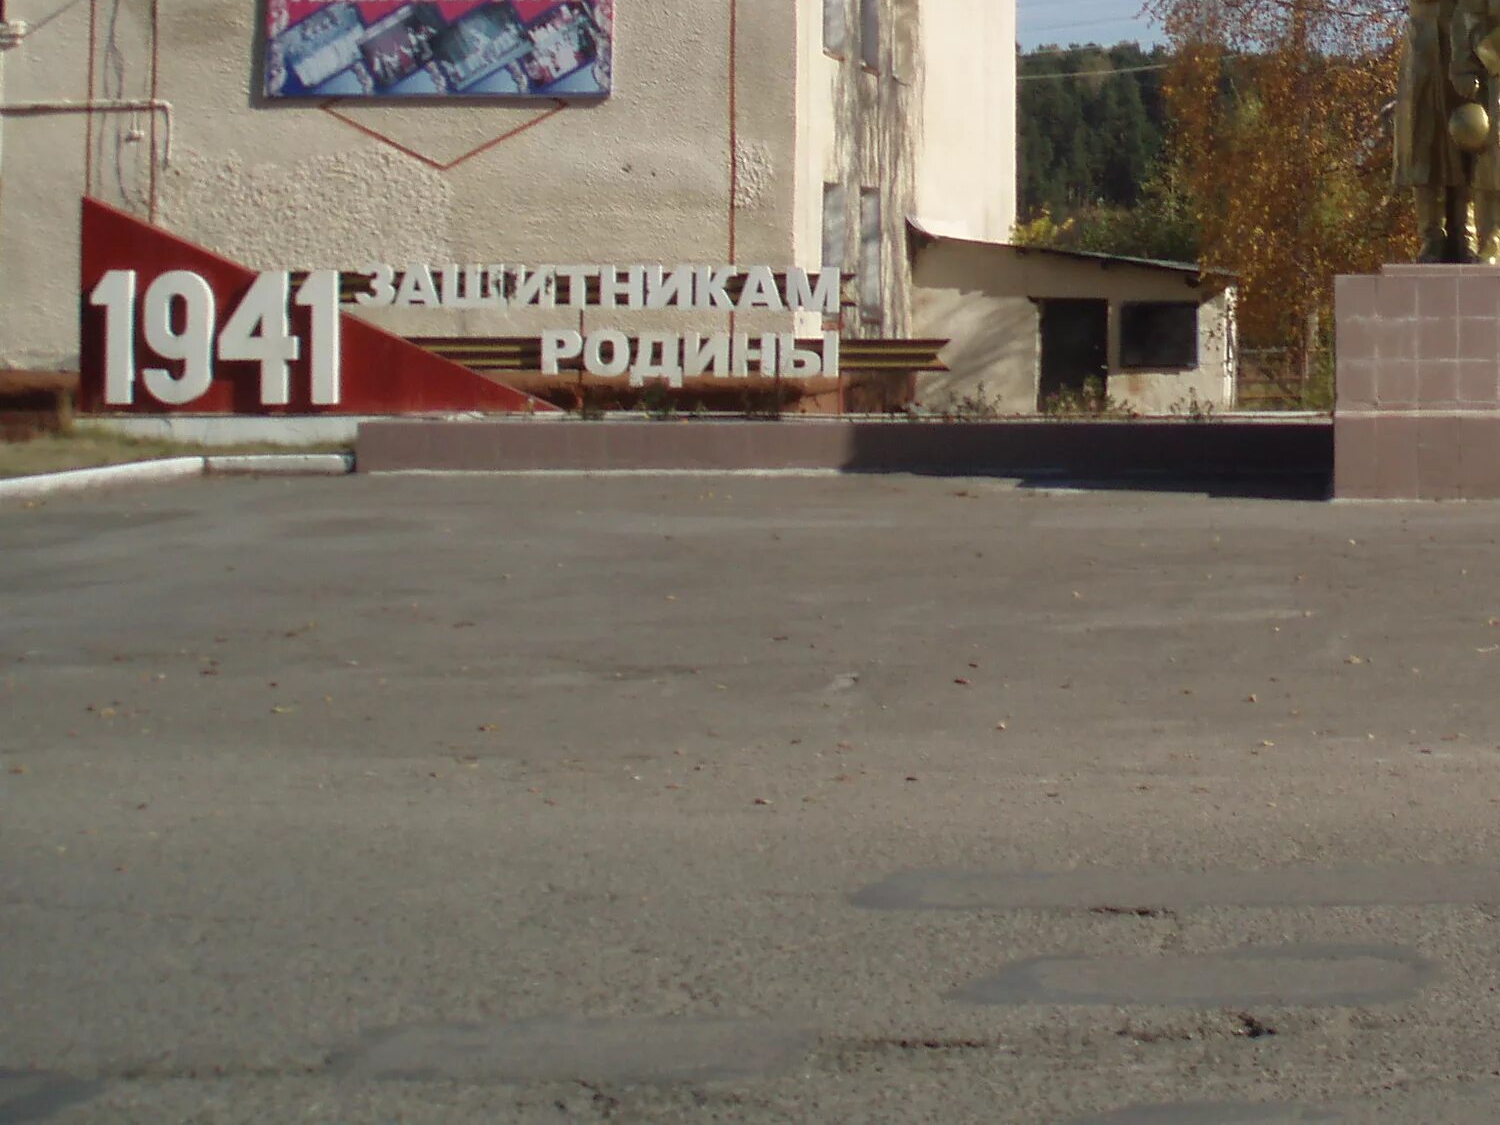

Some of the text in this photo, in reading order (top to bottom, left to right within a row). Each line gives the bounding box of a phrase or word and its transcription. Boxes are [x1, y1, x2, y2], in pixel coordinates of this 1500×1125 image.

[354, 263, 841, 313] ЗАЩИТНИКАМ
[90, 270, 342, 407] 1941
[541, 328, 841, 386] РОДИНЫ
